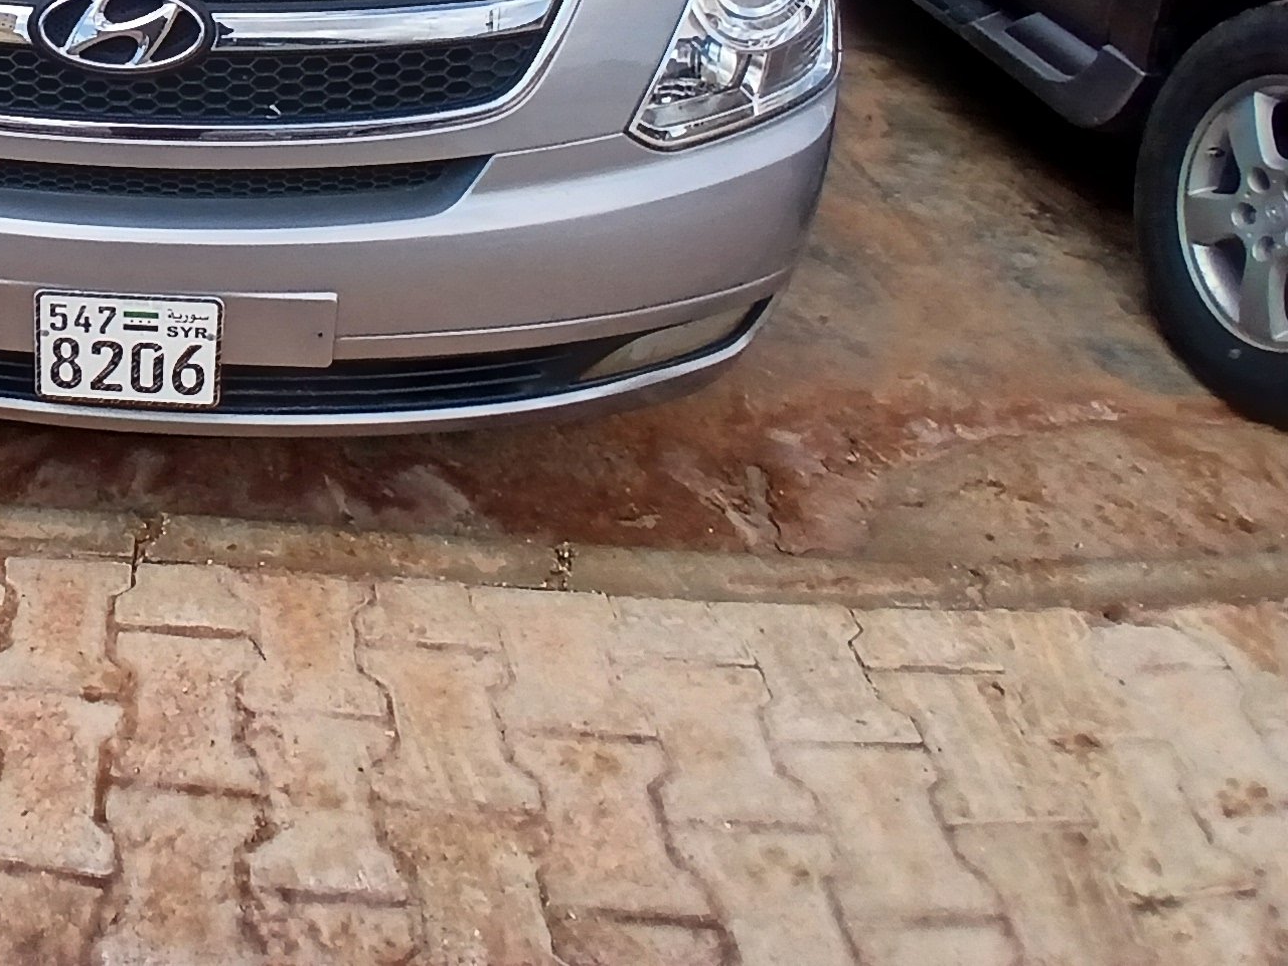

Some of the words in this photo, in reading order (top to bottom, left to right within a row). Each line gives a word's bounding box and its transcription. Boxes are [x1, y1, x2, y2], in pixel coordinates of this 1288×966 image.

[49, 303, 117, 334] 547
[167, 308, 210, 322] سورية
[166, 326, 209, 339] SYR
[50, 337, 205, 396] 8206
